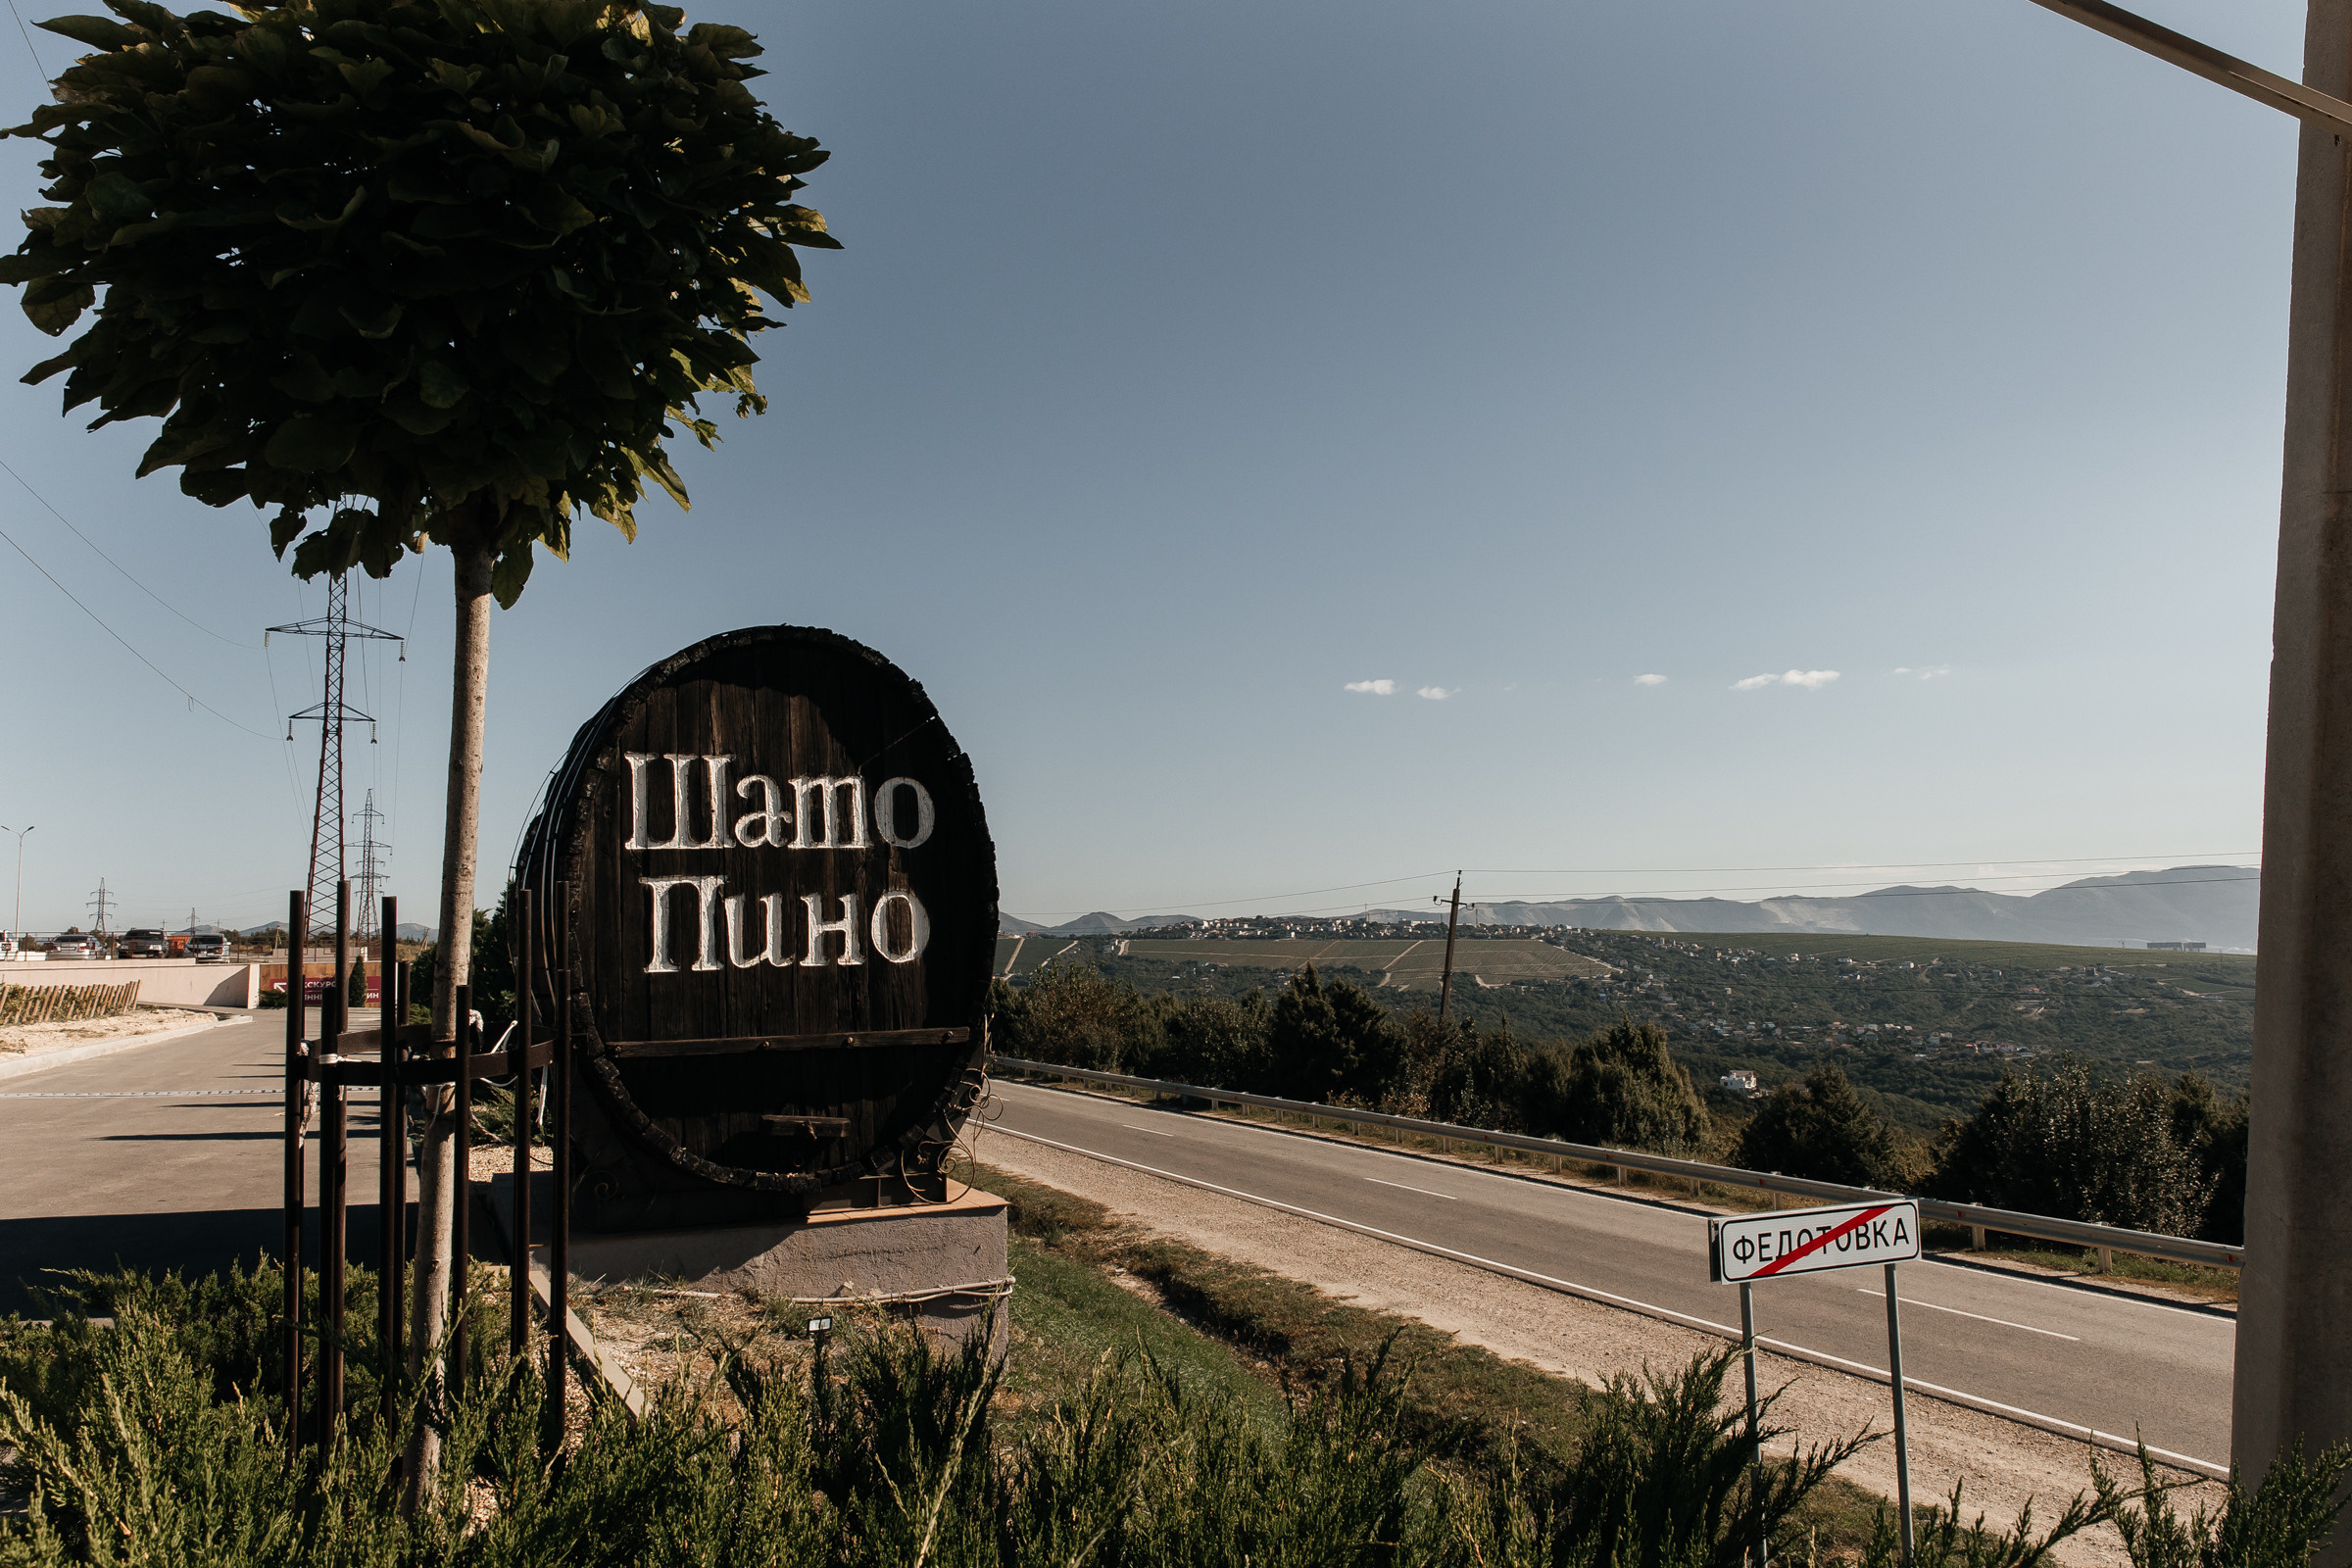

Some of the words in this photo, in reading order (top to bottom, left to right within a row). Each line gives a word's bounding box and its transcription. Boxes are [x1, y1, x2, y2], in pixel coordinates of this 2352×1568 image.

[624, 751, 935, 850] Шато
[638, 875, 930, 973] Пино
[1733, 1217, 1909, 1264] ФЕДОТОВКА
